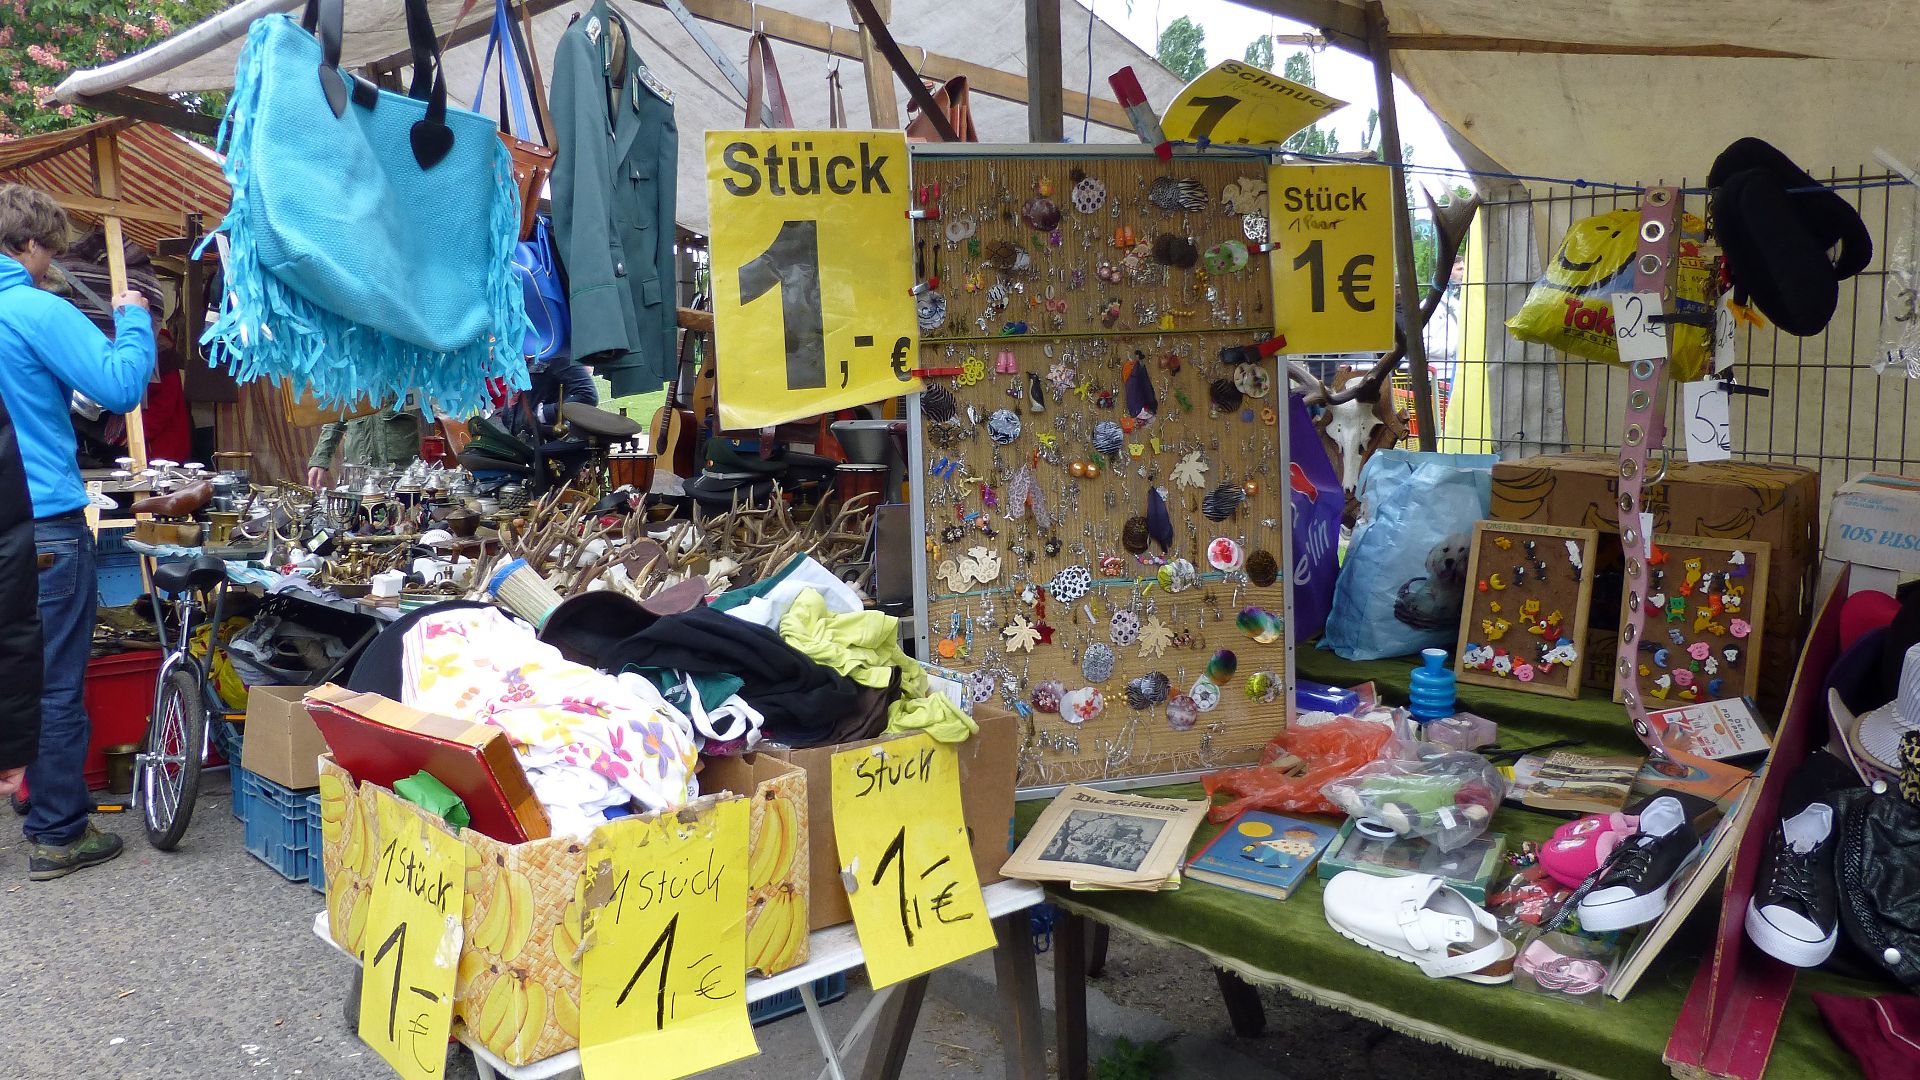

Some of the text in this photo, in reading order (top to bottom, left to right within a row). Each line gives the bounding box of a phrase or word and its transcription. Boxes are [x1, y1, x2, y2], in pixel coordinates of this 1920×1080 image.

[1220, 63, 1340, 112] Schmuck
[723, 142, 891, 197] Stück
[1284, 186, 1367, 212] Stück
[383, 837, 453, 914] 1 Stück
[605, 847, 725, 925] 1 Stück
